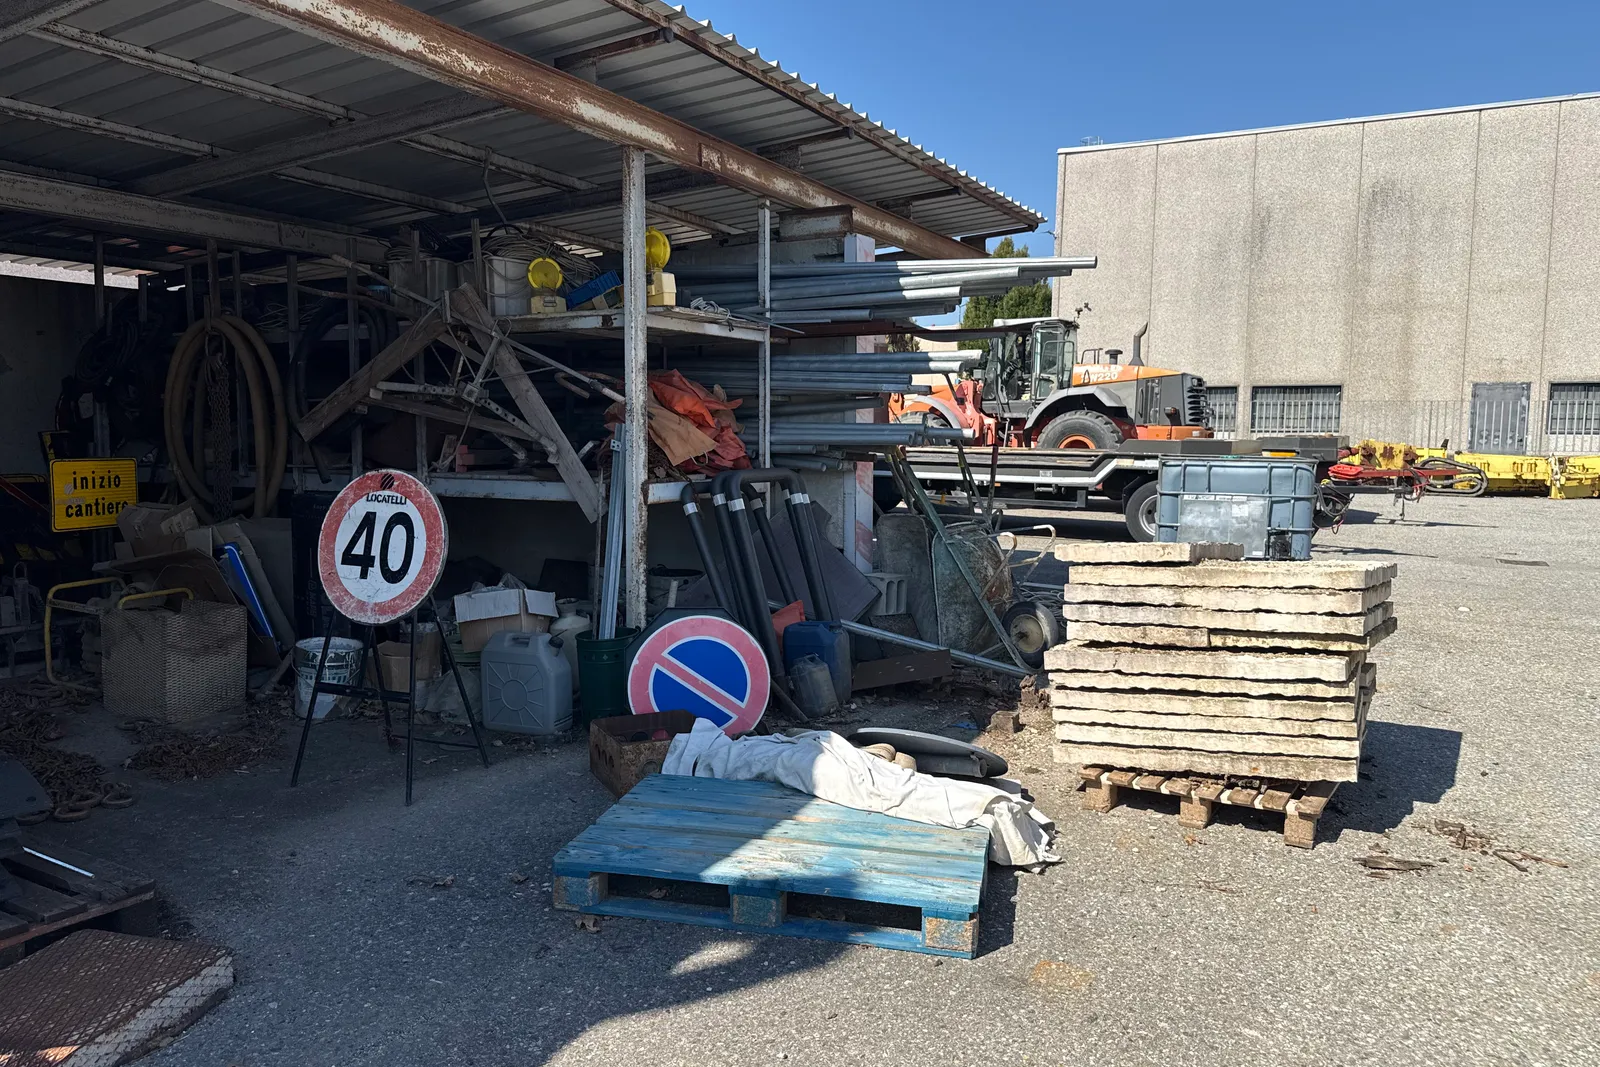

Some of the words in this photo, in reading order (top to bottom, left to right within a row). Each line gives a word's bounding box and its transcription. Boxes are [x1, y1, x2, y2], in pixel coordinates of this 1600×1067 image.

[73, 470, 121, 490] inizio
[366, 492, 408, 505] LOCATELLI
[340, 511, 415, 584] 40
